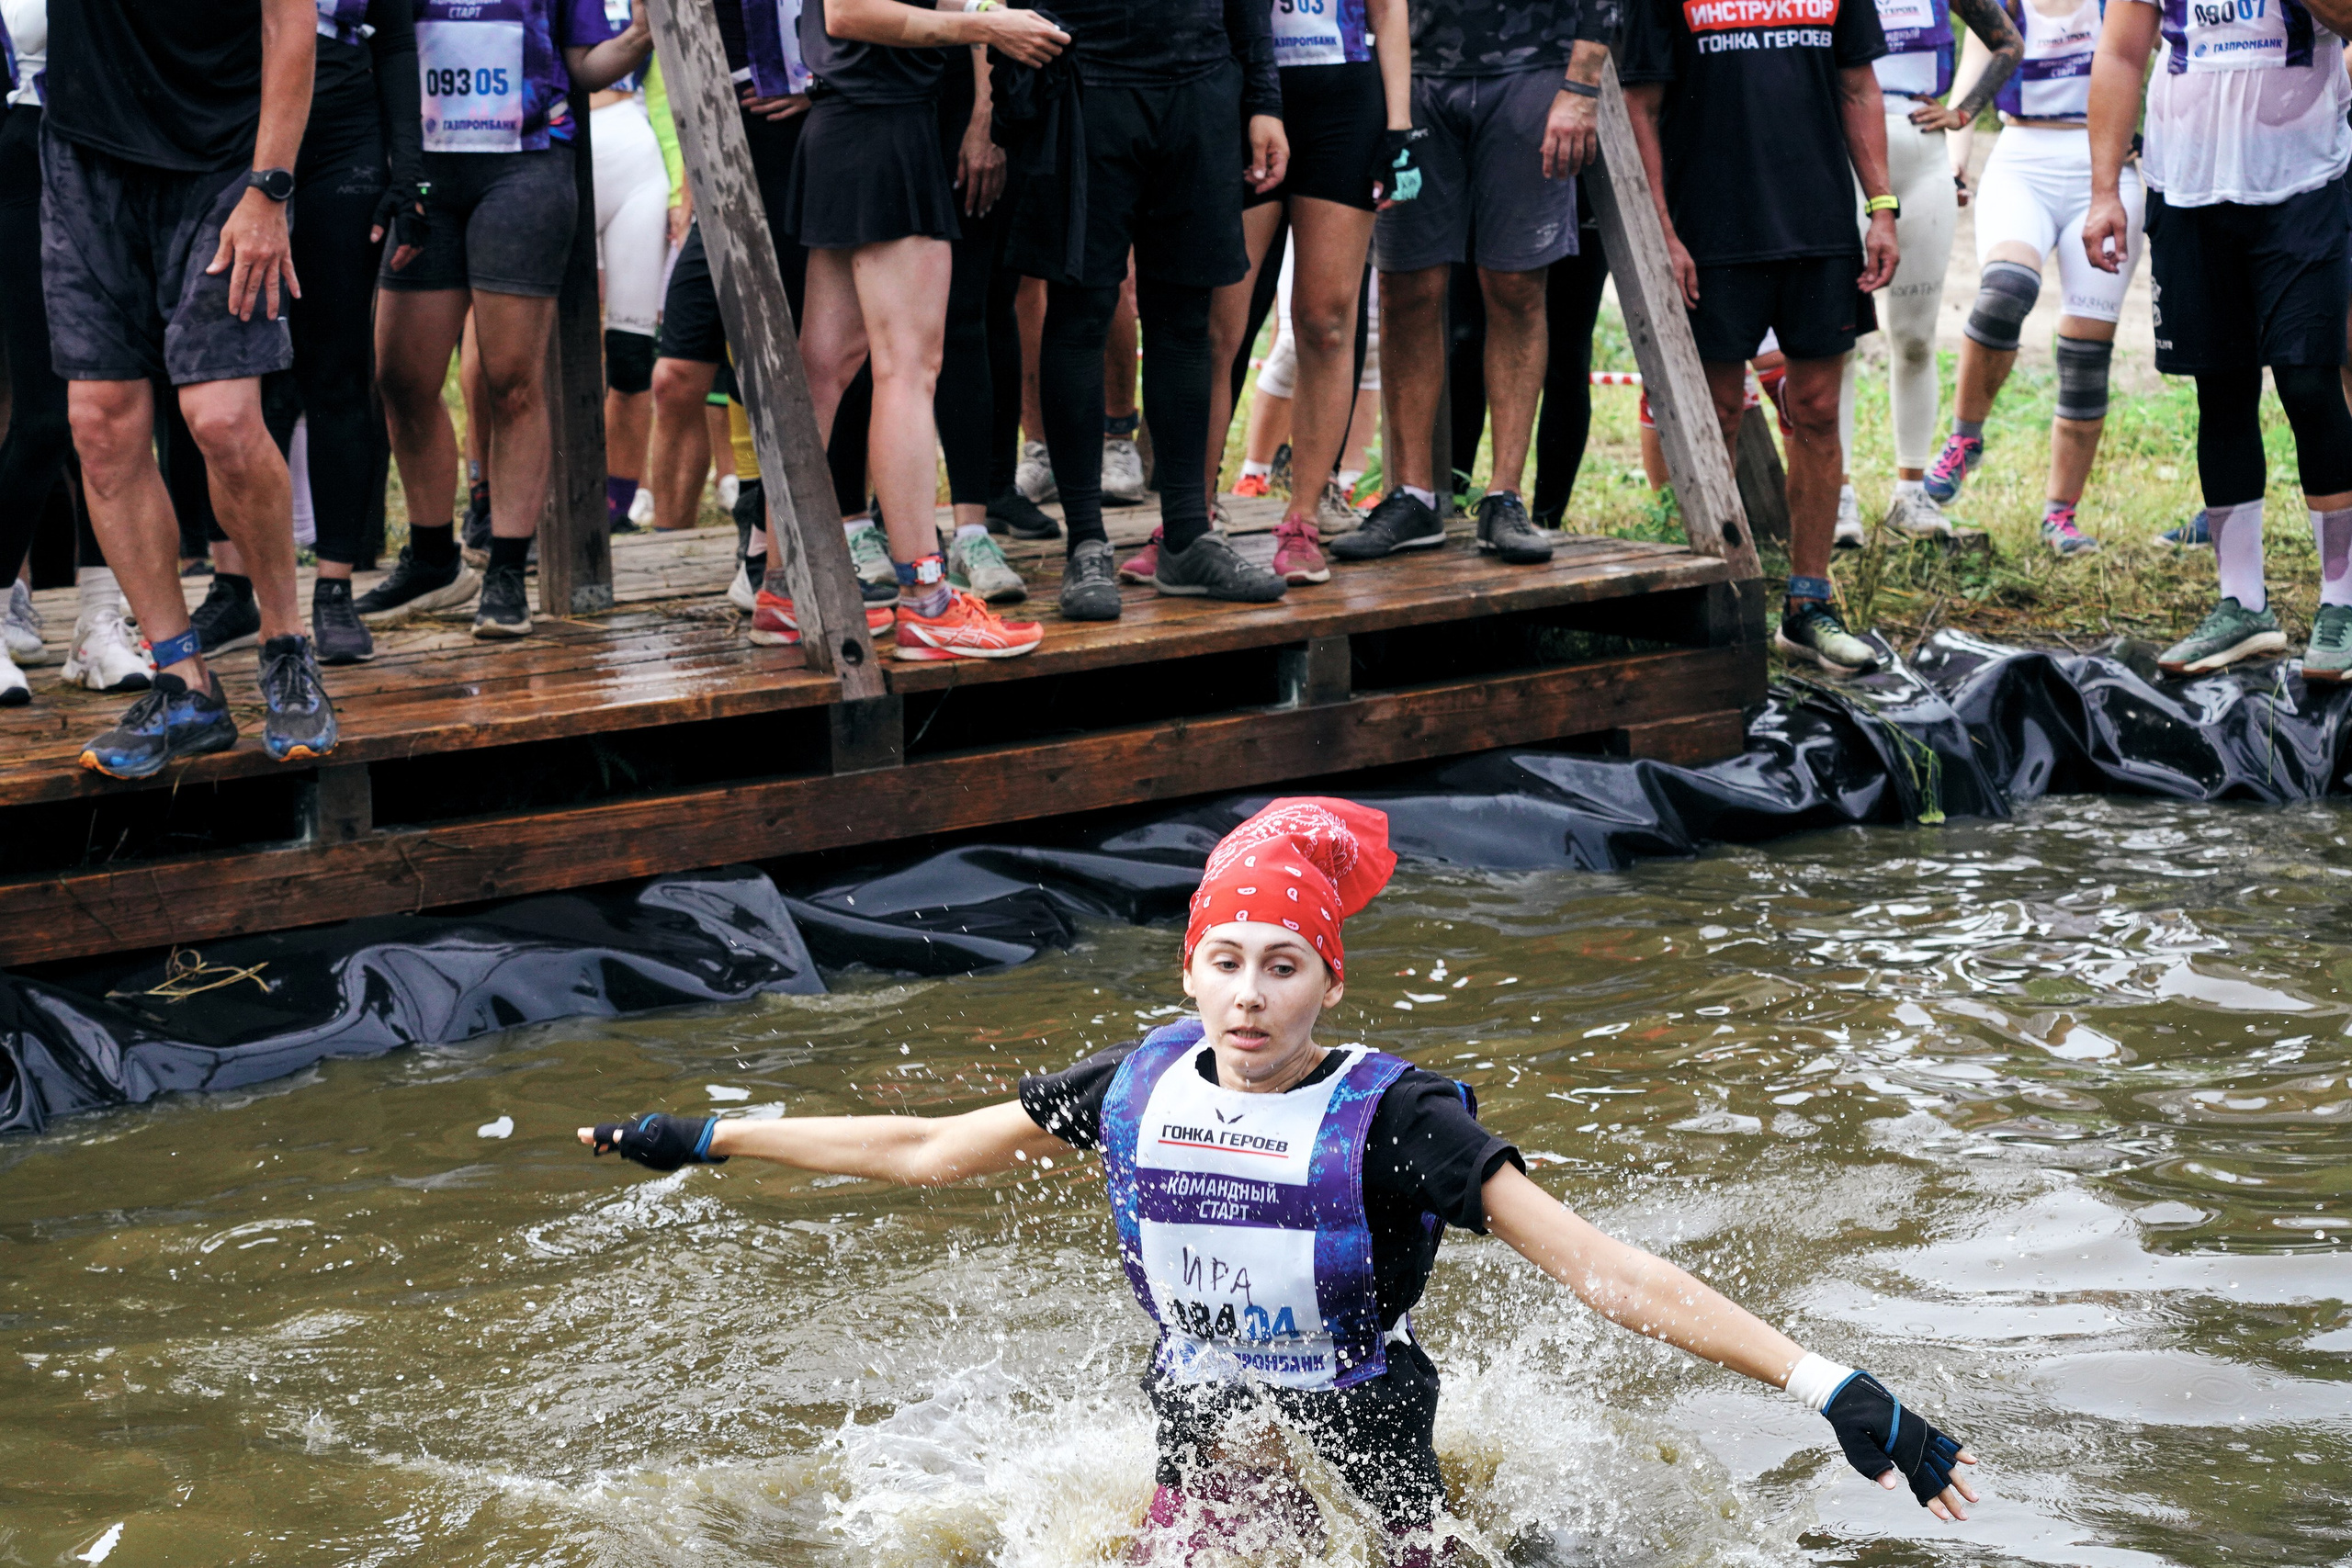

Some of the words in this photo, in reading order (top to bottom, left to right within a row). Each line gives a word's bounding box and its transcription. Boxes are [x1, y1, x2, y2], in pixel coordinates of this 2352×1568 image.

[448, 6, 482, 18] СТАРТ
[1690, 0, 1834, 26] ИНСТРУКТОР
[2194, 0, 2266, 27] 09007
[1274, 36, 1337, 48] АЗПРОМБАНК
[1697, 32, 1759, 54] ГОНКА
[1763, 29, 1833, 48] ГЕРОЕВ
[2213, 38, 2282, 53] ГАЗПРОМБАНК
[426, 68, 509, 96] 09305
[443, 118, 516, 131] ГАЗПРОМБАНК
[1161, 1124, 1214, 1143] ГОНКА
[1219, 1131, 1289, 1153] ГЕРОЕВ
[1166, 1176, 1278, 1203] КОМАНДНЫЙ
[1199, 1201, 1250, 1221] СТАРТ
[1182, 1246, 1253, 1306] ИРА
